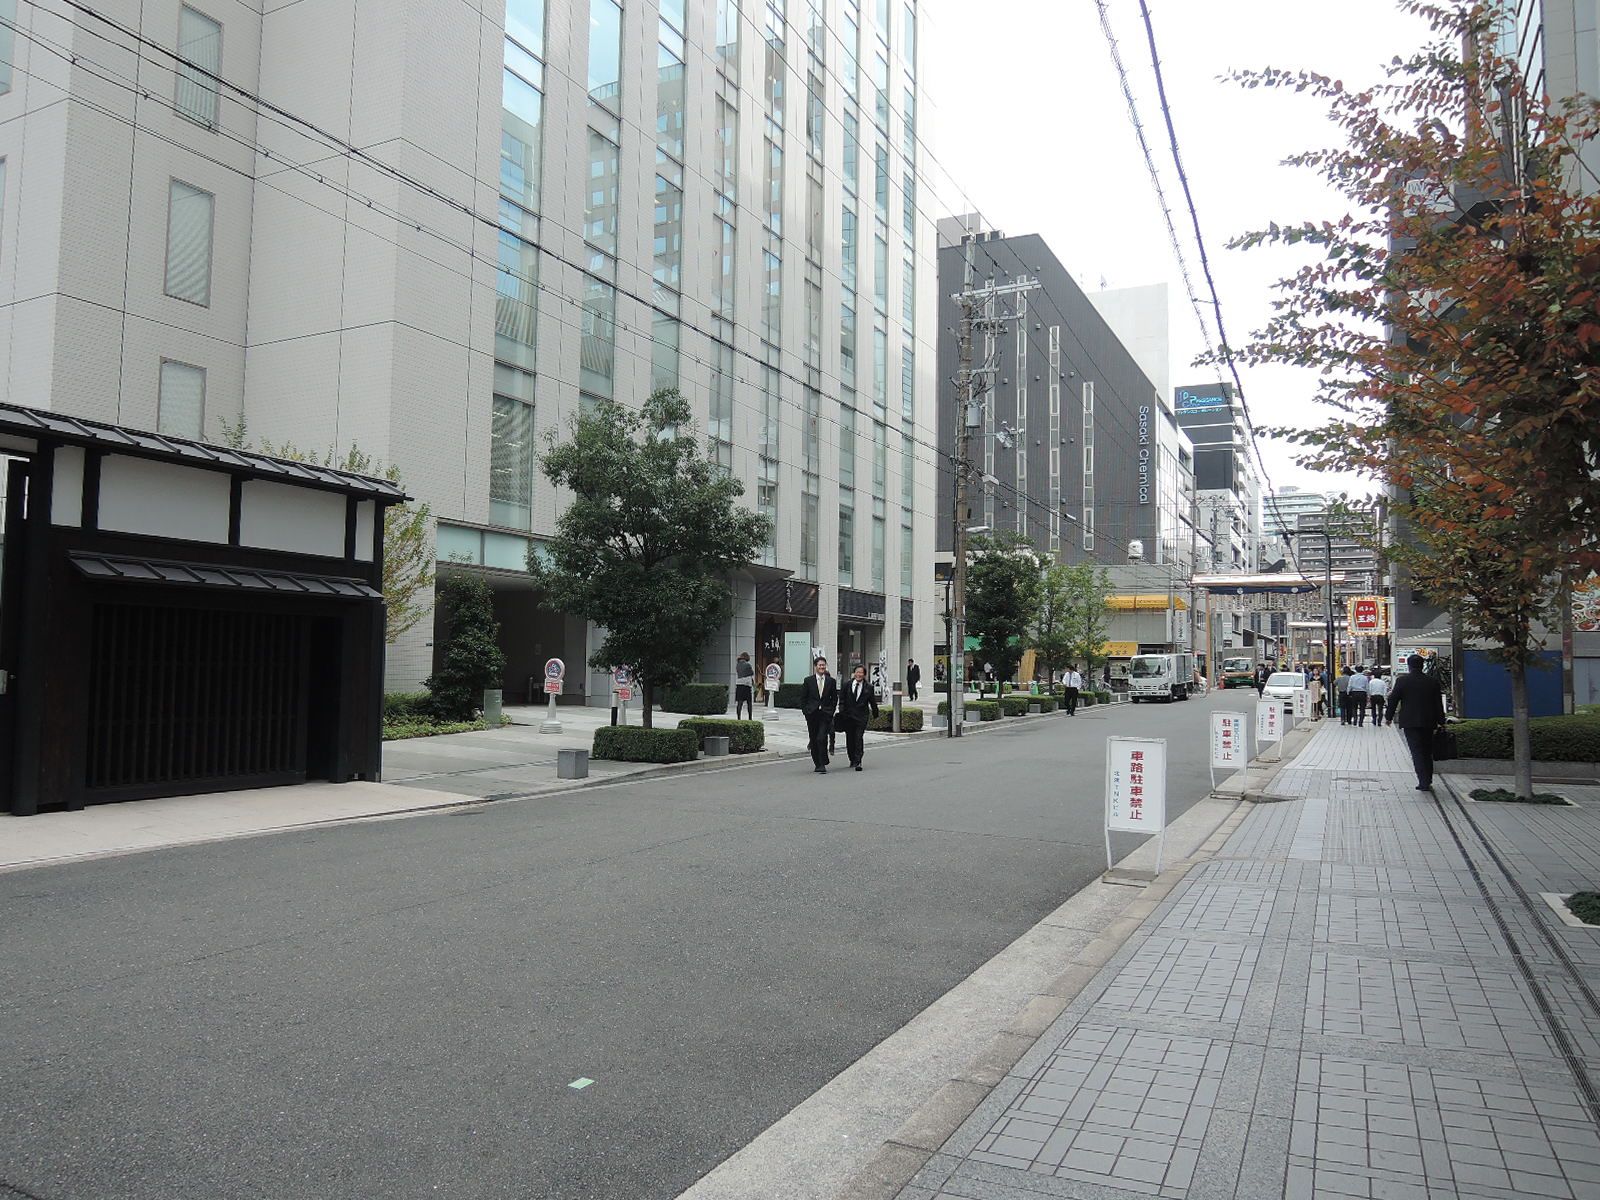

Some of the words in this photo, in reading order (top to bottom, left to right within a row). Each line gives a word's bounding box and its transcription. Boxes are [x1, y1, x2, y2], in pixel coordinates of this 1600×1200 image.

[1139, 405, 1148, 445] Sasaki
[1139, 449, 1149, 505] Chemical
[1357, 614, 1376, 623] 王将
[1222, 718, 1232, 760] 駐車禁止
[1268, 706, 1276, 735] 駐車禁止
[1129, 750, 1144, 820] 車路駐車禁止
